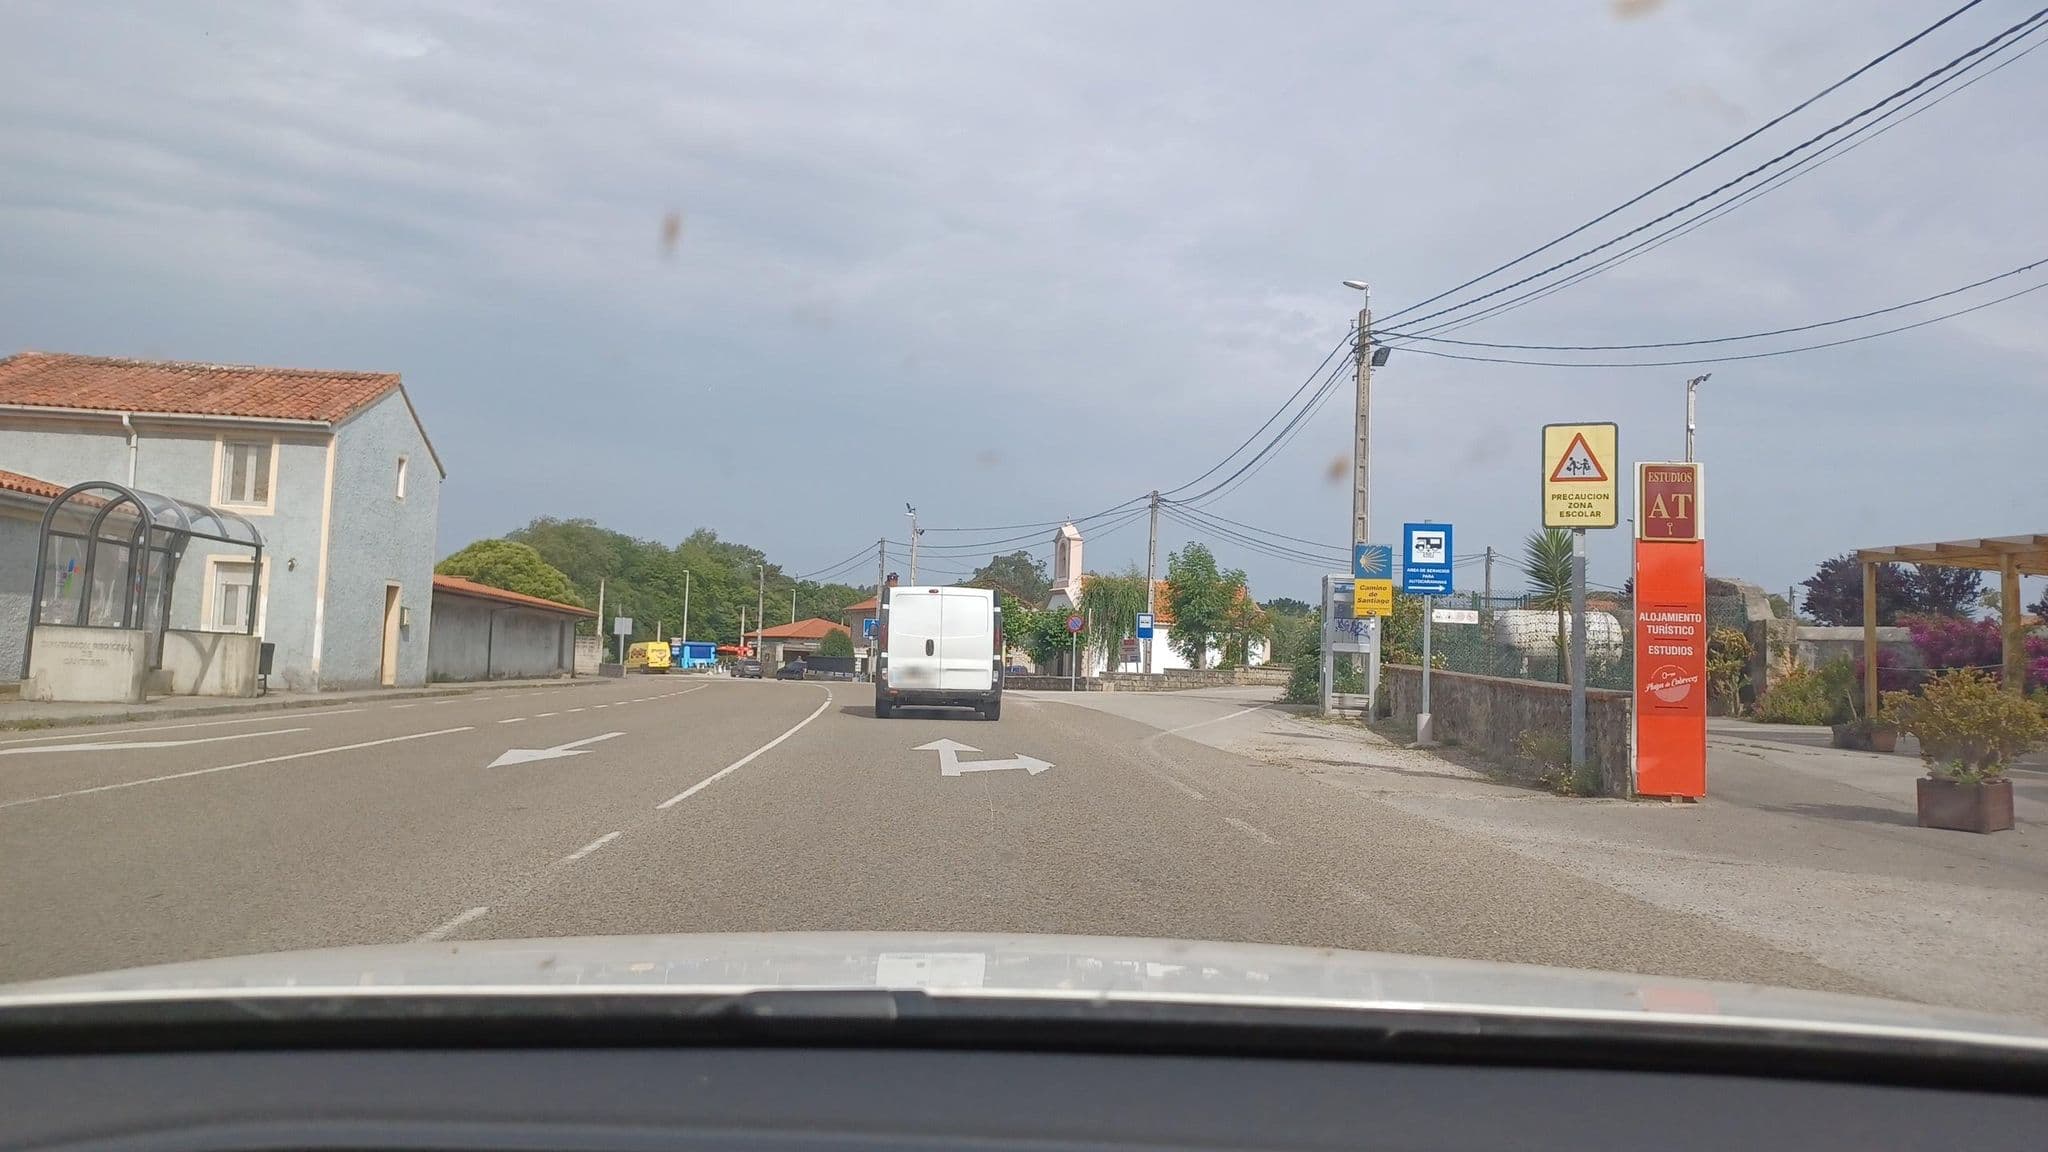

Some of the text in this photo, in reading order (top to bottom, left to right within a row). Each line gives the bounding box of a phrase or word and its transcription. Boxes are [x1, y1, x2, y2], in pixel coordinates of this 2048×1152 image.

[1647, 471, 1693, 483] ESTUDIOS
[1551, 492, 1610, 501] PRECAUCION
[1648, 492, 1692, 520] AT
[1559, 510, 1602, 518] ESCOLAR
[1357, 597, 1390, 605] Santiago
[1639, 612, 1702, 622] ALOJAMIENTO
[1646, 624, 1695, 635] TURÍSTICO
[1648, 645, 1694, 656] ESTUDIOS
